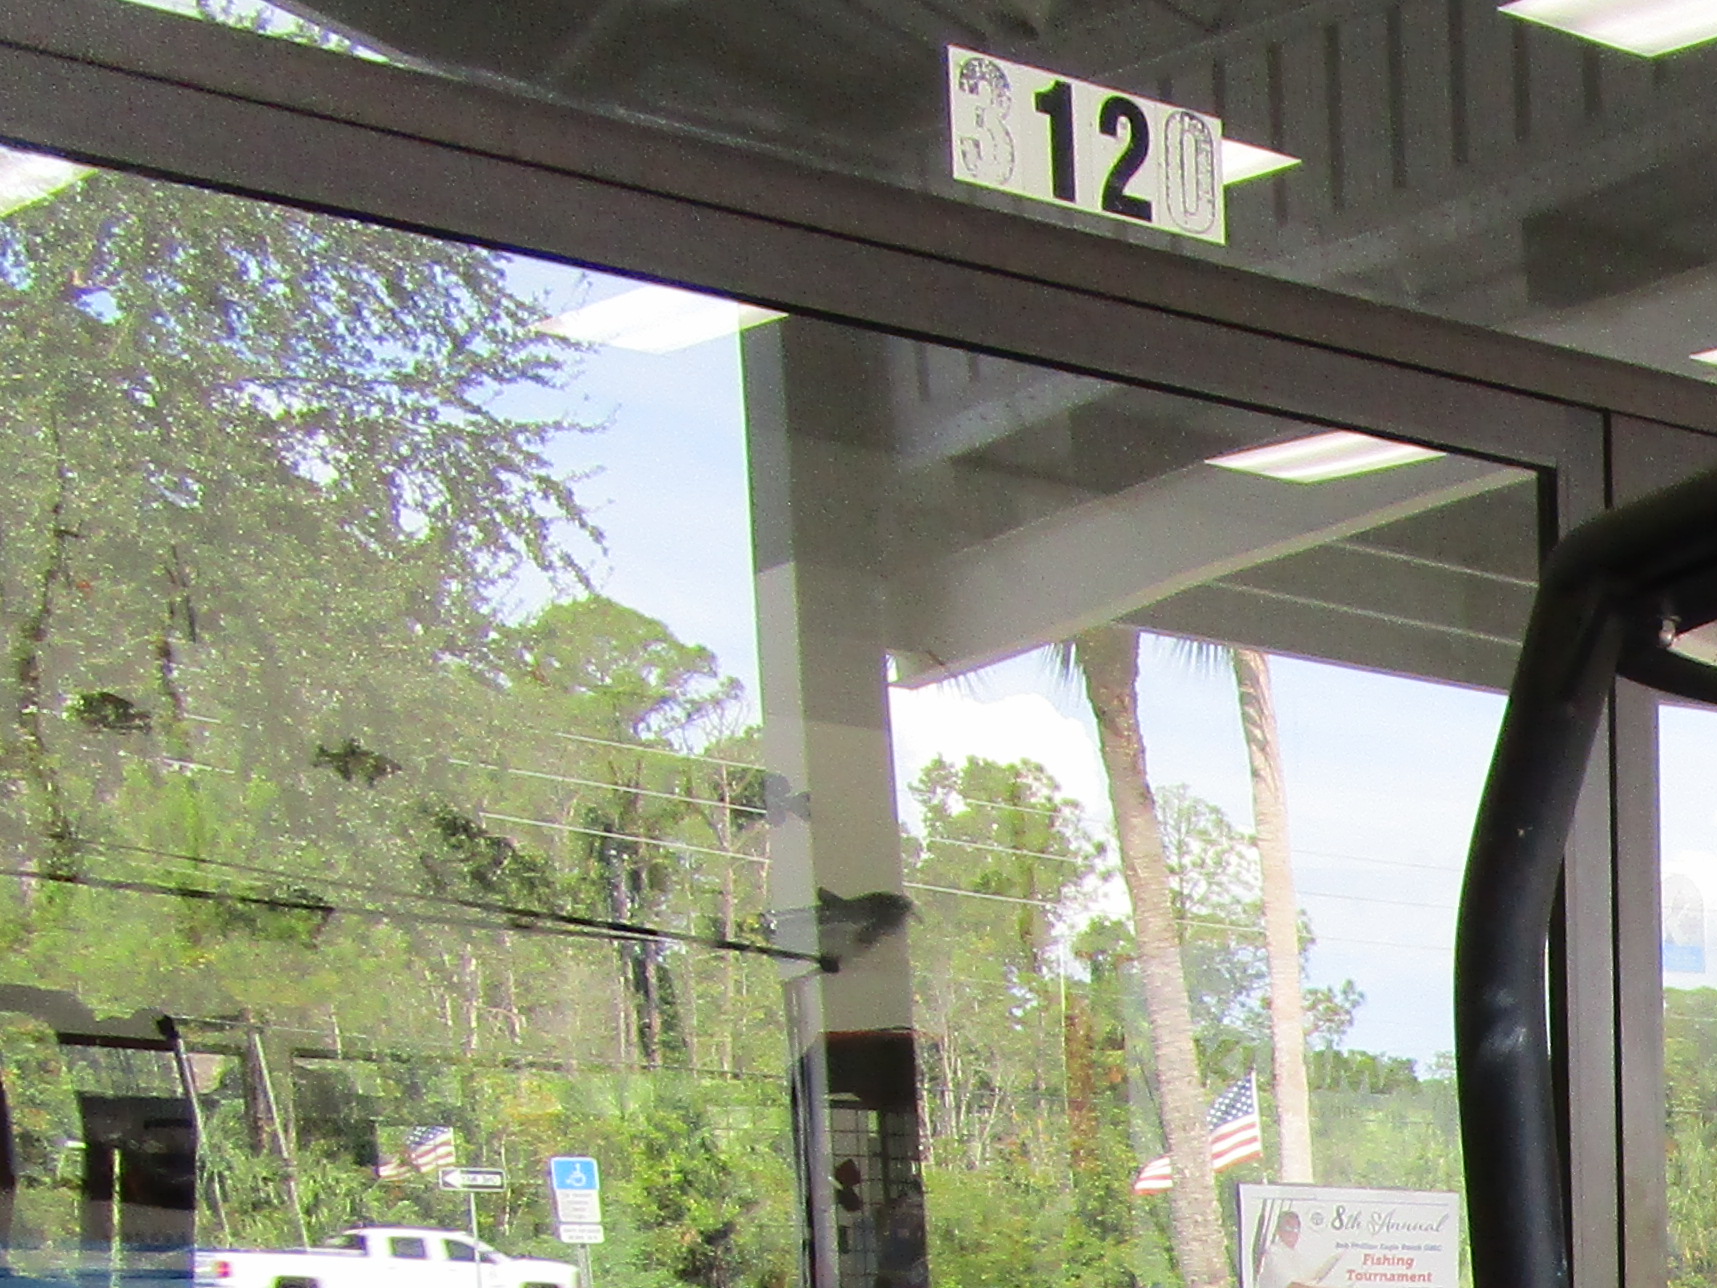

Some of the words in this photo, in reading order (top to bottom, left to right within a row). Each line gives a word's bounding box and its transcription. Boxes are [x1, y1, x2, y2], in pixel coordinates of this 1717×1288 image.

[1368, 1209, 1449, 1235] Annual
[1362, 1254, 1415, 1269] Fishing
[1346, 1270, 1433, 1283] Tournament
